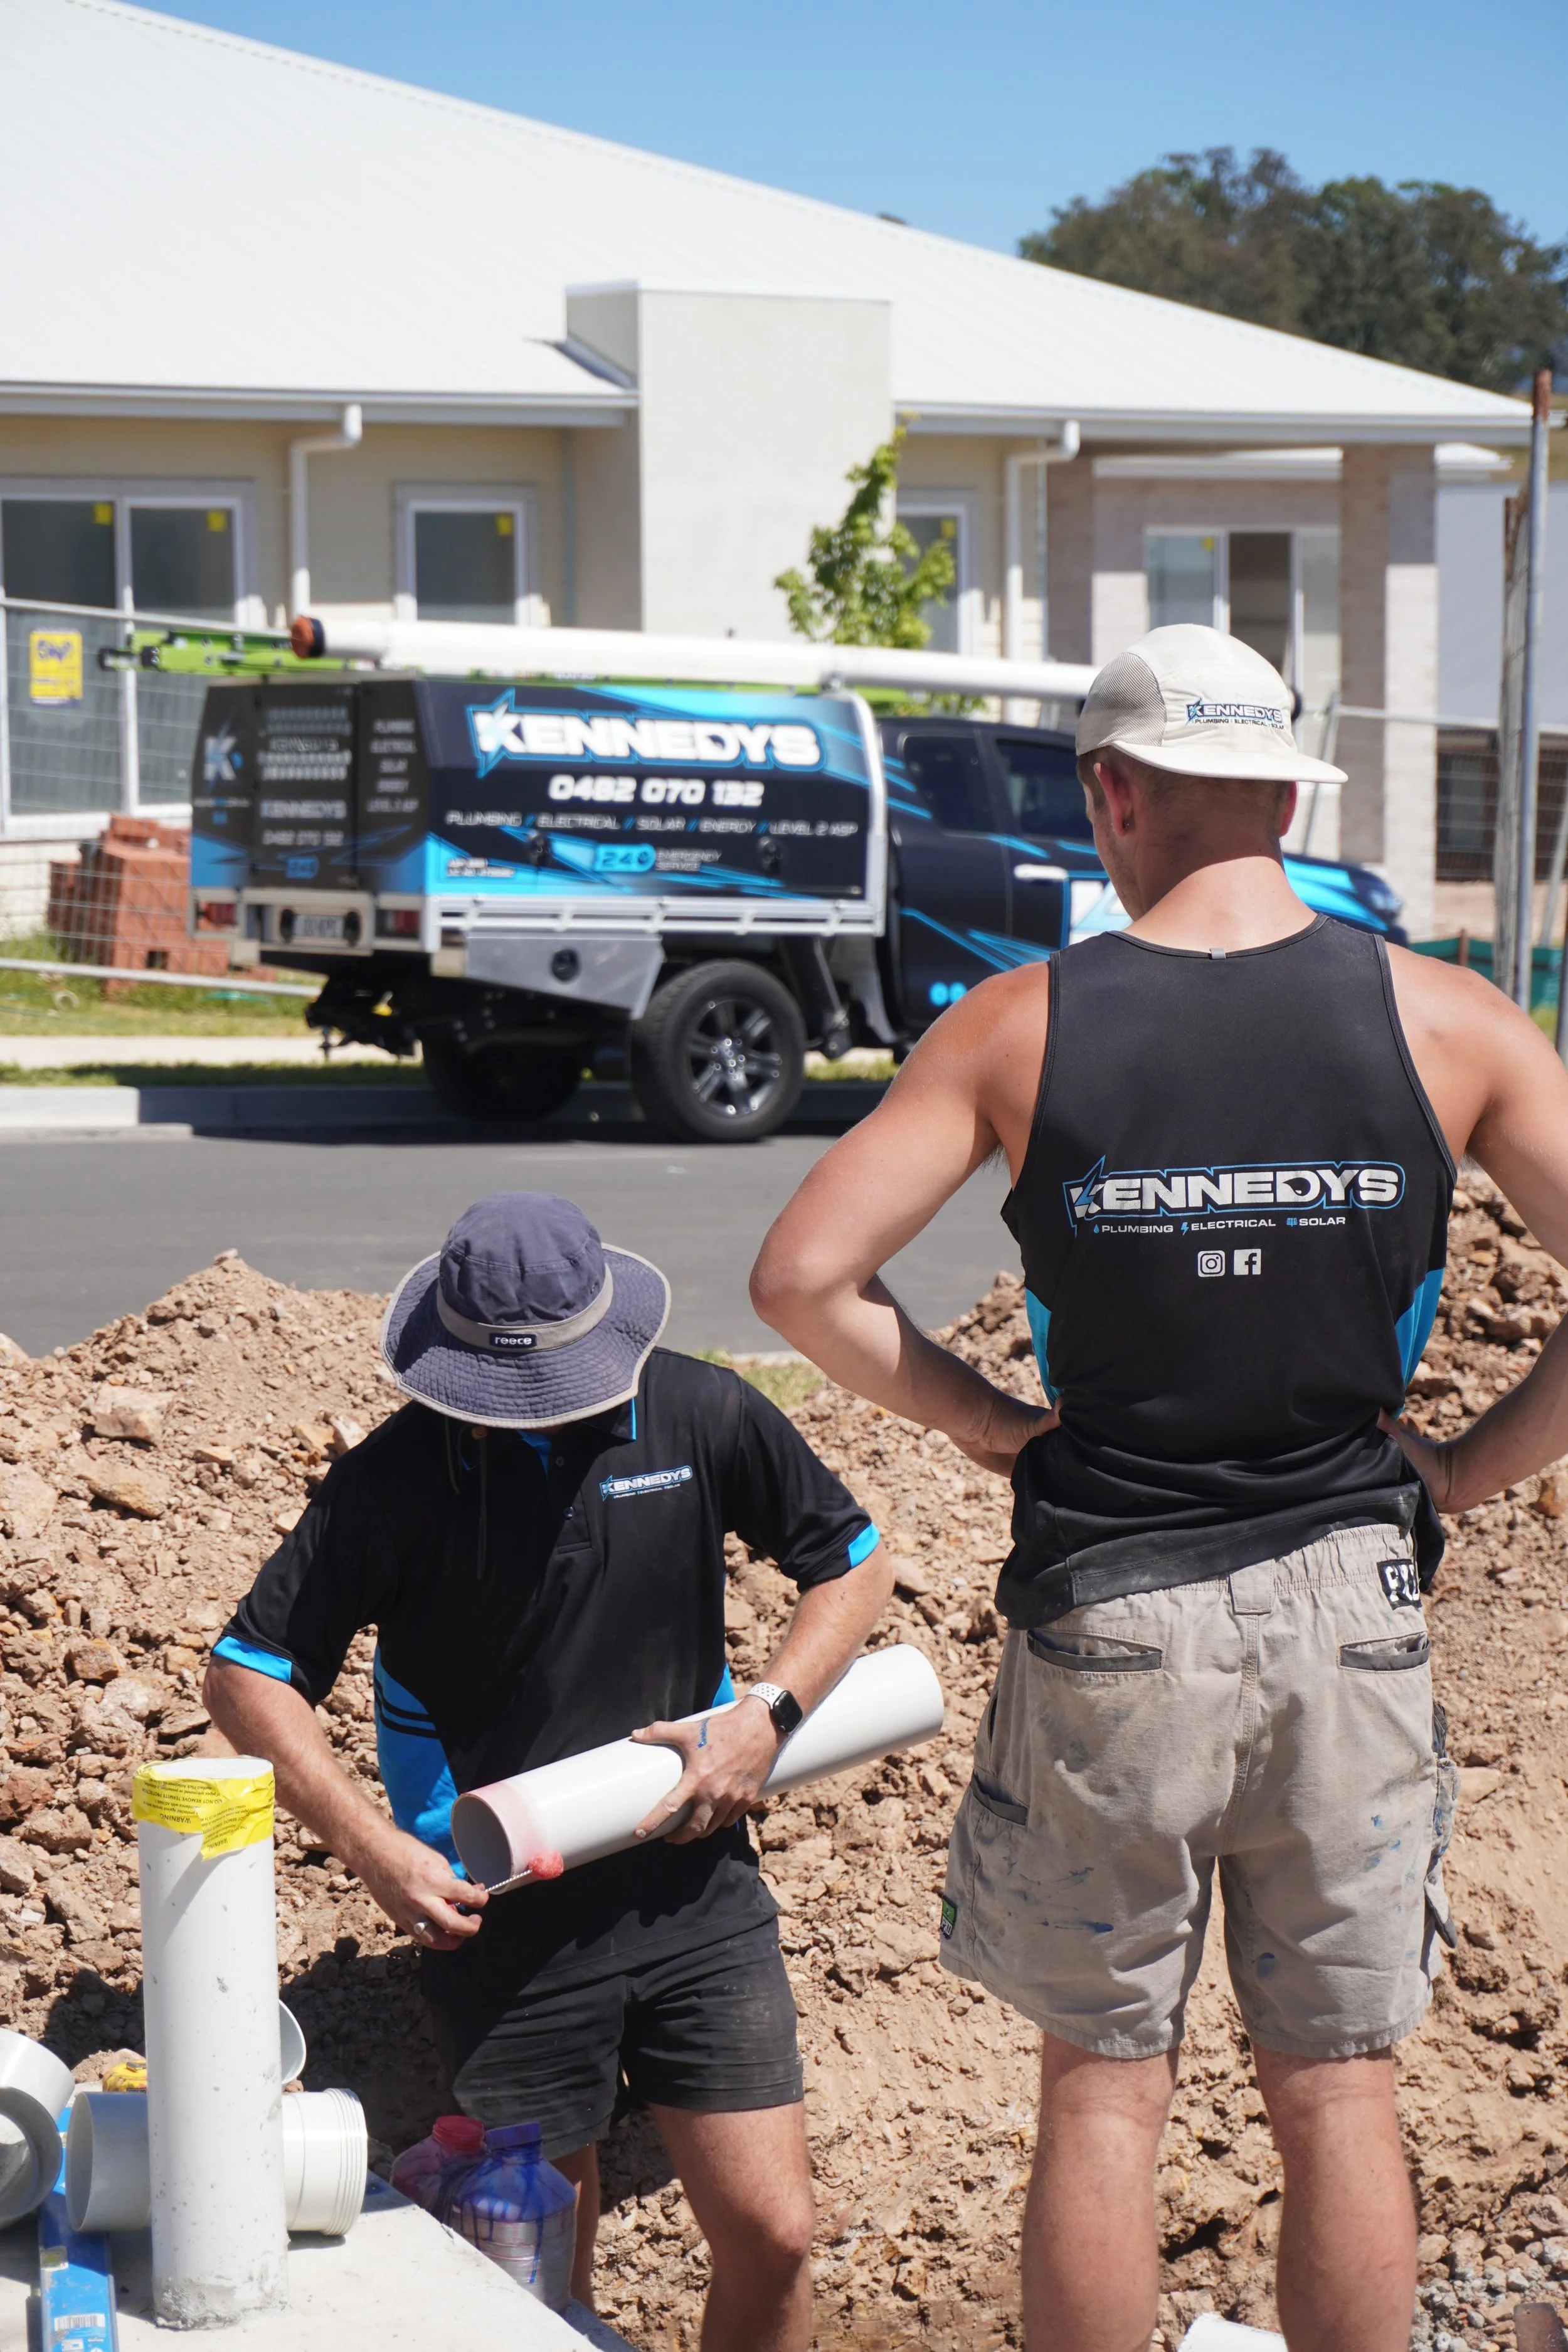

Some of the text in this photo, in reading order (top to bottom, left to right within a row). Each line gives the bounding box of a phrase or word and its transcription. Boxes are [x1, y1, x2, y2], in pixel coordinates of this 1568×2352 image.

[1188, 702, 1283, 723] KENNEDYS
[472, 707, 820, 766] KENNEDYS
[549, 775, 765, 807] 0482 070 132
[446, 810, 859, 837] PLUMBING ELECTRICAL SOLAR ENERGY LEVEL 2 ASP
[1069, 1167, 1399, 1218] KENNEDYS
[1101, 1216, 1346, 1234] PLUMBING ELECTRICAL SOLAR
[494, 1336, 532, 1345] reece
[601, 1467, 691, 1495] KENNEDYS
[160, 1813, 191, 1824] WARNING
